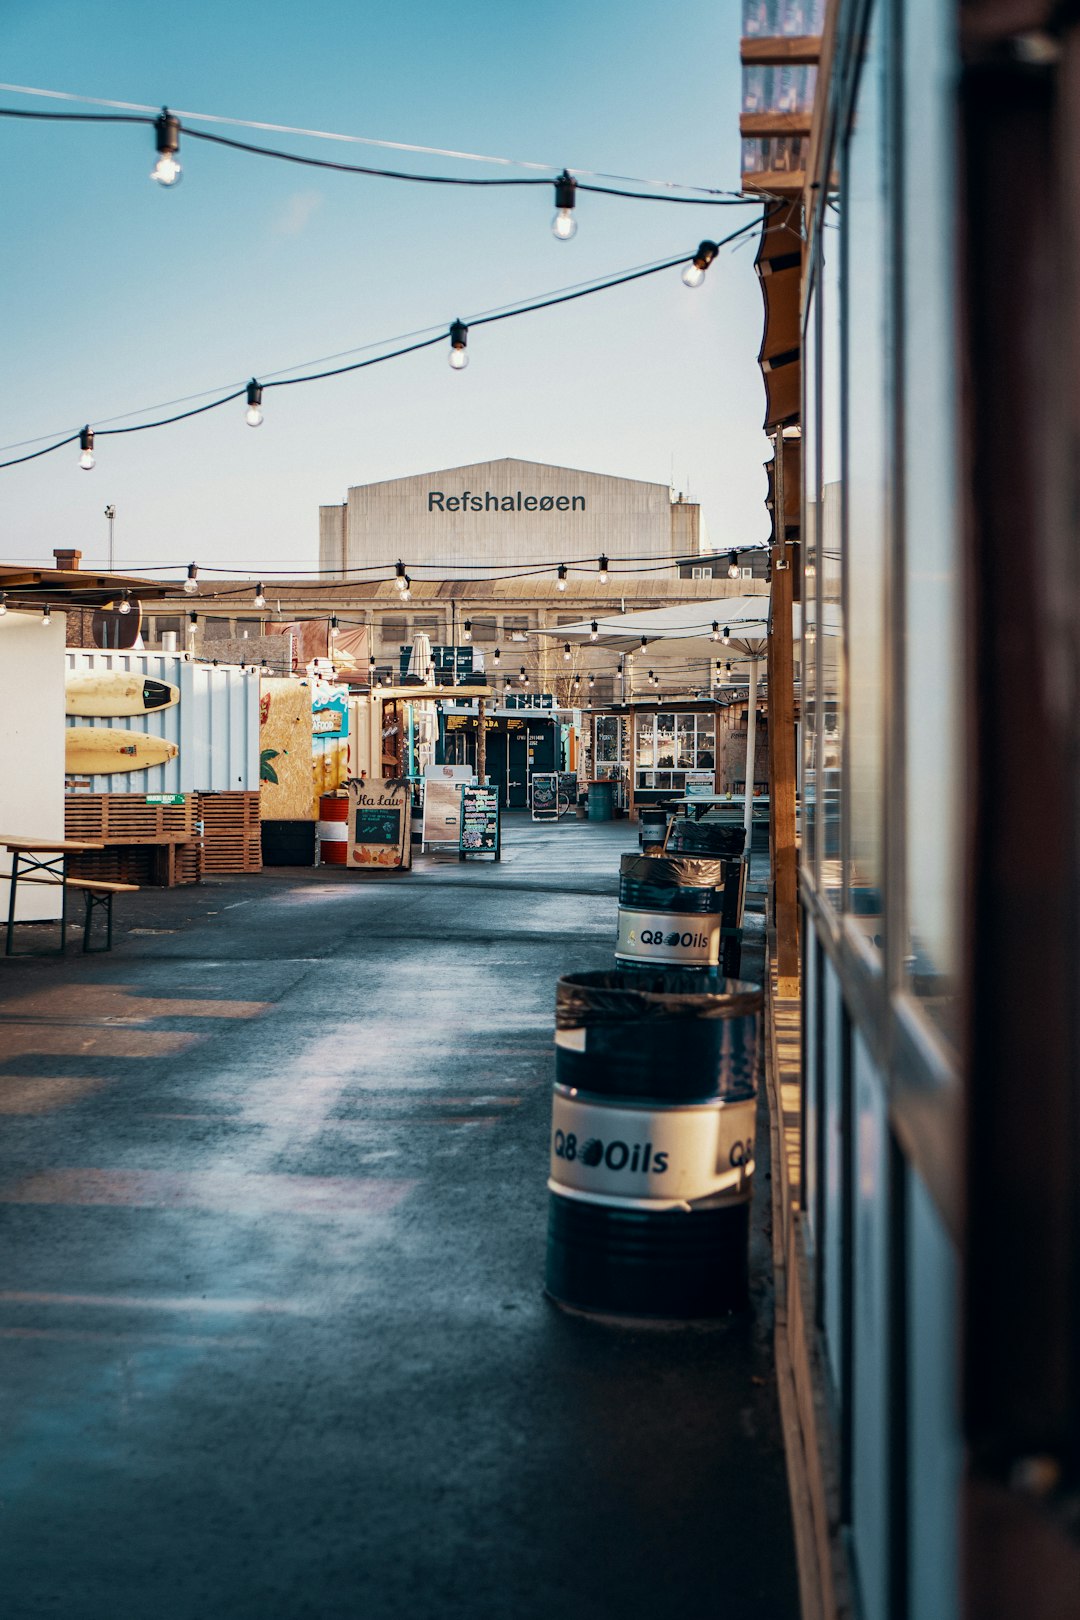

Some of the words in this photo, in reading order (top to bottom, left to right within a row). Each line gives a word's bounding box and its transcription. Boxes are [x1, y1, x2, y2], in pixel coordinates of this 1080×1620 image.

[428, 491, 586, 512] Refshaleøen
[472, 719, 499, 728] DABA
[357, 794, 375, 806] Ha
[377, 794, 400, 806] Lau
[641, 930, 663, 945] Q8
[680, 932, 709, 948] Oils
[555, 1128, 577, 1162] Q8
[605, 1140, 669, 1174] Oils
